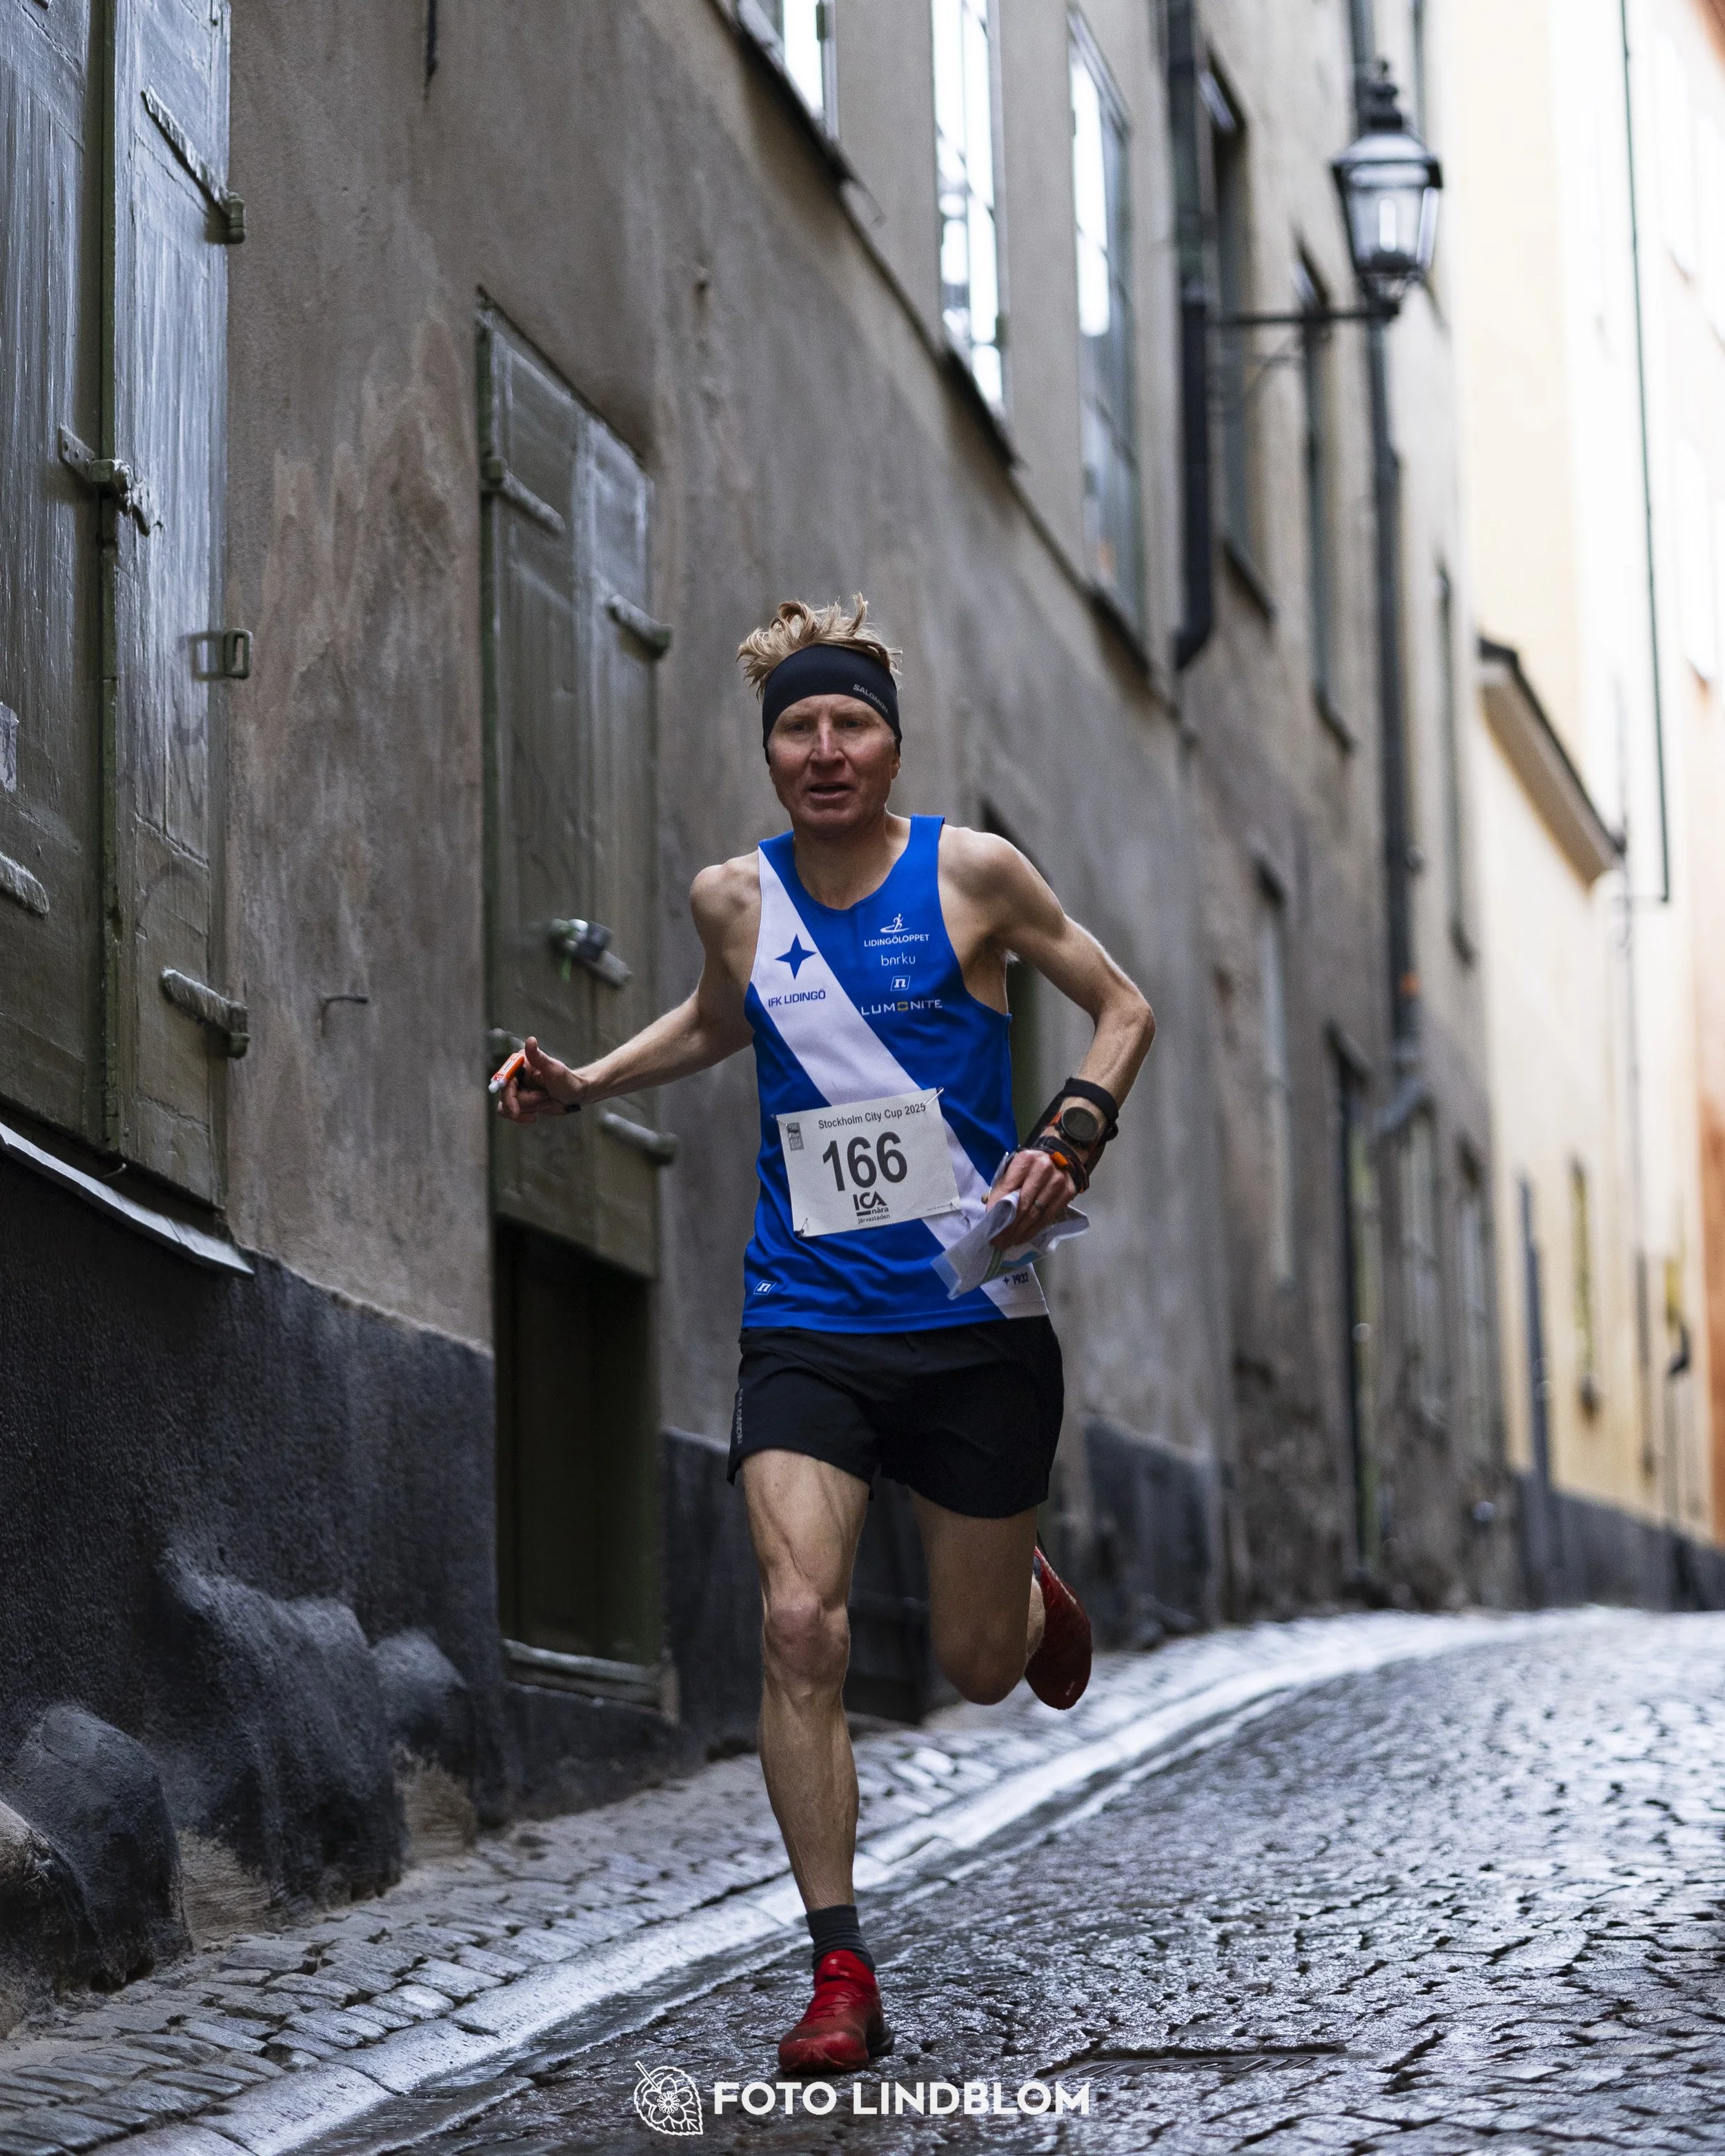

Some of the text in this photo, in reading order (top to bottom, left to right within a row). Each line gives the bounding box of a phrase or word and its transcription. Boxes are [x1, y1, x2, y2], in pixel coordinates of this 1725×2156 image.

[864, 933, 929, 947] LIDINGÖLOPPET
[768, 988, 826, 1008] IFK LIDINGÖ
[860, 999, 943, 1016] LUMONITE
[818, 1102, 927, 1129] Stockholm City Cup 2025
[822, 1131, 908, 1192] 166
[852, 1190, 887, 1211] ICA
[871, 1207, 889, 1215] nära
[1012, 1272, 1029, 1285] 1932
